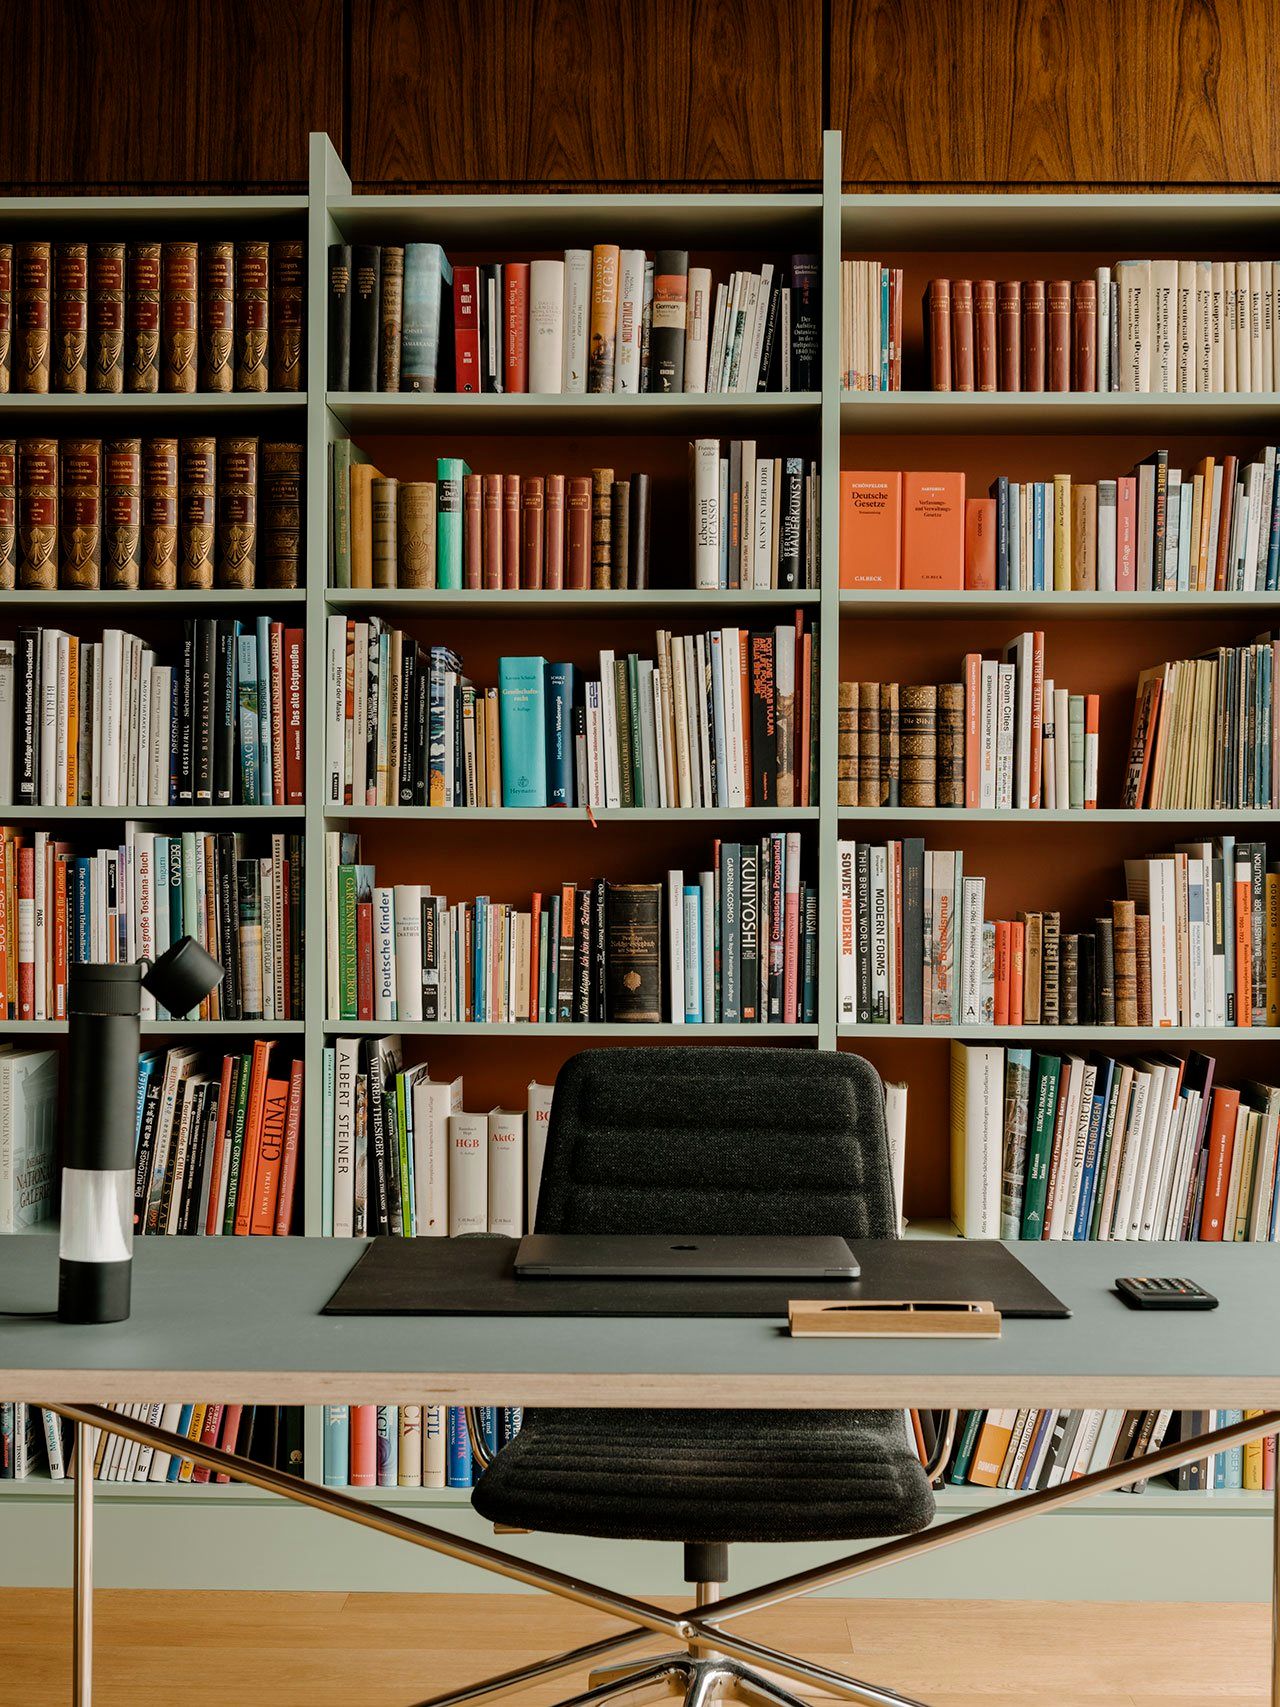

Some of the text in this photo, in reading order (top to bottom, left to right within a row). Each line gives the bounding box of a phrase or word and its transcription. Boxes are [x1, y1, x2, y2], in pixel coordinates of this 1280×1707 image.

[595, 256, 603, 303] ORLANDO
[603, 257, 614, 303] FIGES
[622, 300, 634, 341] CIVILIZATION
[656, 302, 679, 310] Germany
[1133, 341, 1141, 391] Федерация
[760, 509, 766, 518] IN
[791, 477, 801, 557] MAUERKUNST
[852, 492, 888, 500] Deutsche
[854, 500, 885, 508] Gesetze
[1157, 464, 1166, 526] DOUBLE BILLING
[699, 519, 707, 546] Leben
[708, 498, 717, 546] PICASSO
[1123, 545, 1131, 560] Ruge
[25, 639, 33, 678] Deutschland
[766, 637, 774, 678] POST ZANG
[46, 685, 55, 726] BERLIN
[272, 672, 280, 714] HUNDERT
[290, 644, 301, 725] Das alte Ostpreußen
[1003, 674, 1012, 732] Dream Cities
[1033, 649, 1041, 729] DIE MITTE BERLINS
[244, 712, 254, 766] SACHSEN
[273, 738, 281, 782] HAMBURG
[158, 856, 167, 886] Ungarn
[171, 844, 181, 886] BELGRAD
[773, 840, 781, 888] Propaganda
[859, 850, 867, 873] THIS
[140, 852, 151, 942] große Toskana-Buch
[742, 857, 755, 947] KUNIYOSHI
[806, 896, 816, 934] HOKUSAI
[842, 852, 853, 955] SOWJETMODERNE
[346, 877, 355, 1006] GARTENKUNST IN EUROPA
[380, 893, 391, 998] Deutsche Kinder
[426, 921, 434, 962] ORIENTALIST
[580, 896, 590, 968] Ich bin ein Berliner
[876, 888, 885, 976] MODERN FORMS
[938, 896, 948, 990] SOS Brutalismus
[579, 971, 590, 1017] Nina Hagen
[261, 1096, 286, 1162] CHINA
[286, 1074, 302, 1151] DAS ALTE CHINA
[338, 1053, 349, 1174] ALBERT STEINER
[370, 1057, 384, 1157] WILFRED THESIGER
[1073, 1071, 1095, 1168] SIEBENBÜRGEN
[1105, 1121, 1114, 1137] Gottes
[175, 1100, 191, 1180] Tourist Guide to CHINA
[228, 1109, 244, 1208] CHINAS GROSSE MAUER
[456, 1139, 480, 1148] HGB
[492, 1134, 516, 1142] AktG
[1086, 1103, 1102, 1168] SIEBENBÜRGEN
[137, 1150, 147, 1185] HUTONGS
[49, 1427, 57, 1451] Mythos
[205, 1407, 215, 1432] CAPITAL
[1017, 1417, 1035, 1461] JOURNEYS
[978, 1460, 999, 1473] DUMONT
